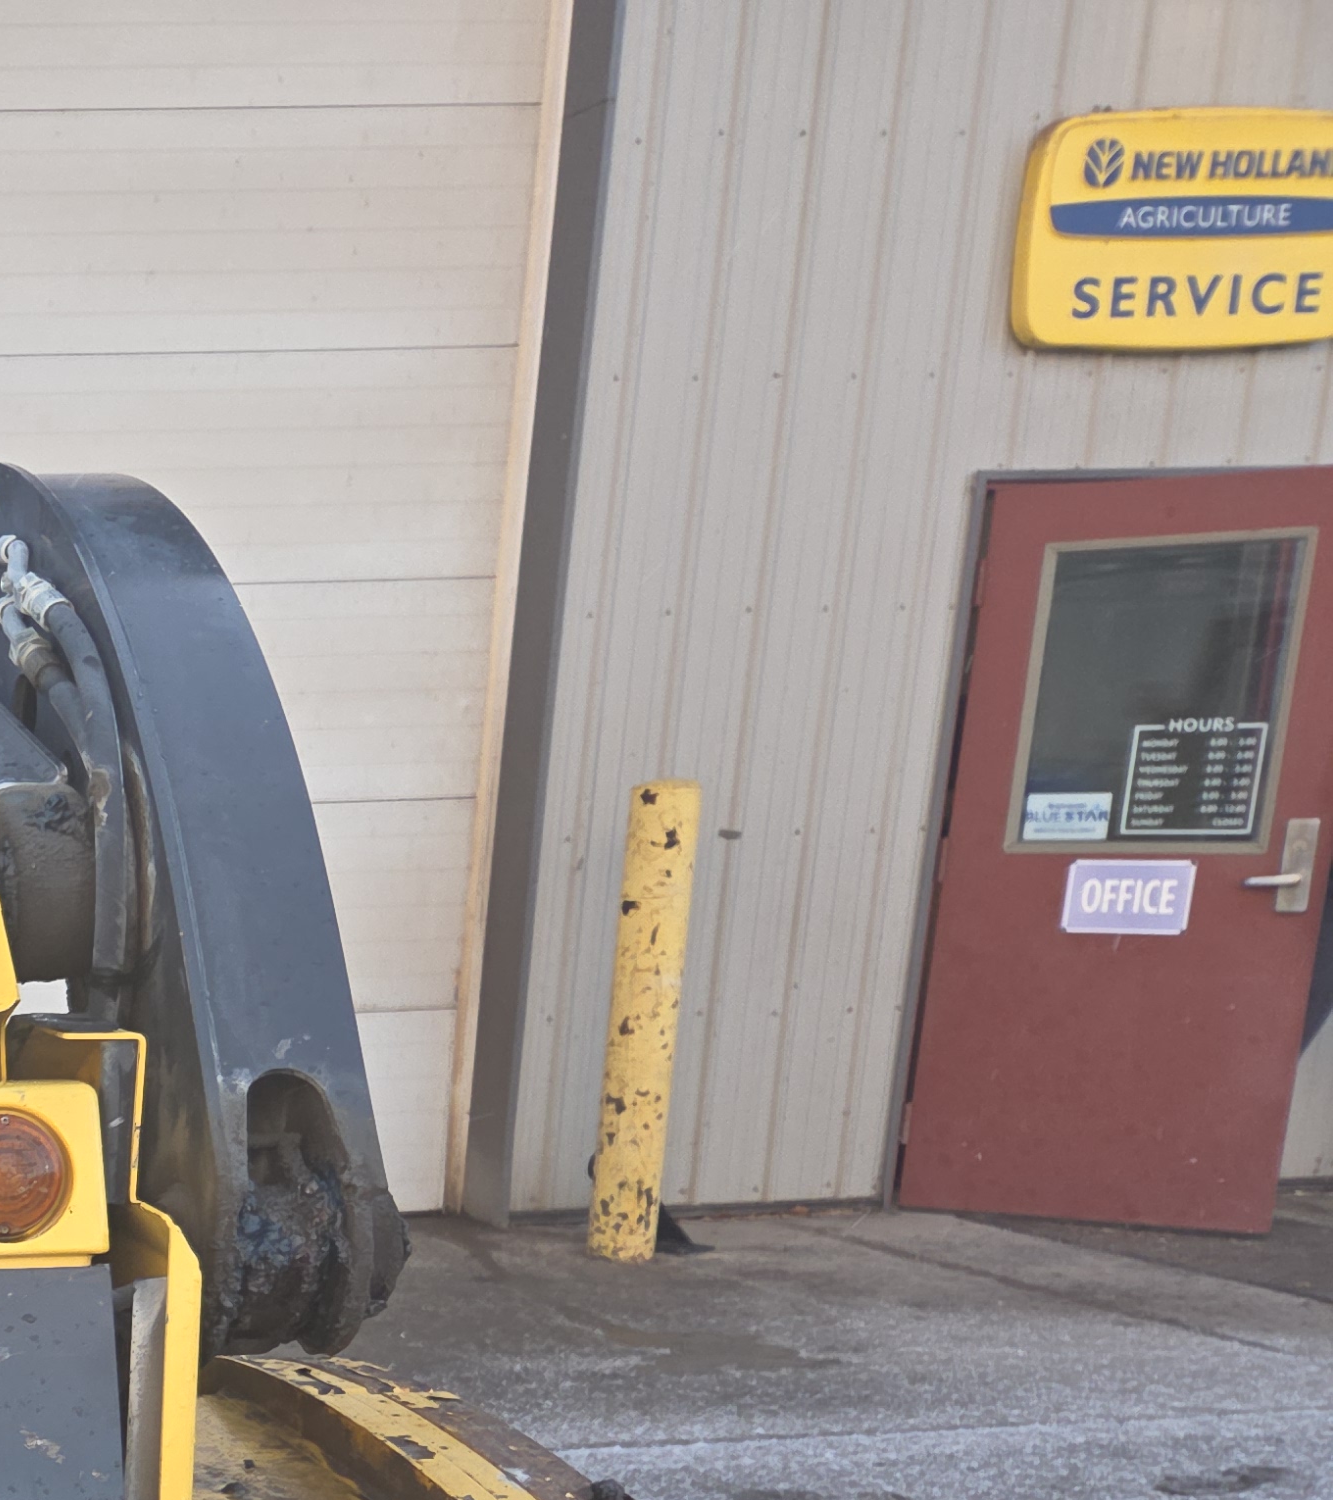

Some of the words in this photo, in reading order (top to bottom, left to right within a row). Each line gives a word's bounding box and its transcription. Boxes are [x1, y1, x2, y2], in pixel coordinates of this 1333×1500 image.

[1130, 149, 1203, 181] NEW
[1208, 148, 1333, 180] HOLLAN
[1121, 203, 1292, 229] AGRICULTURE
[1071, 271, 1324, 320] SERVICE
[1168, 716, 1235, 733] HOURS
[1081, 877, 1178, 917] OFFICE
